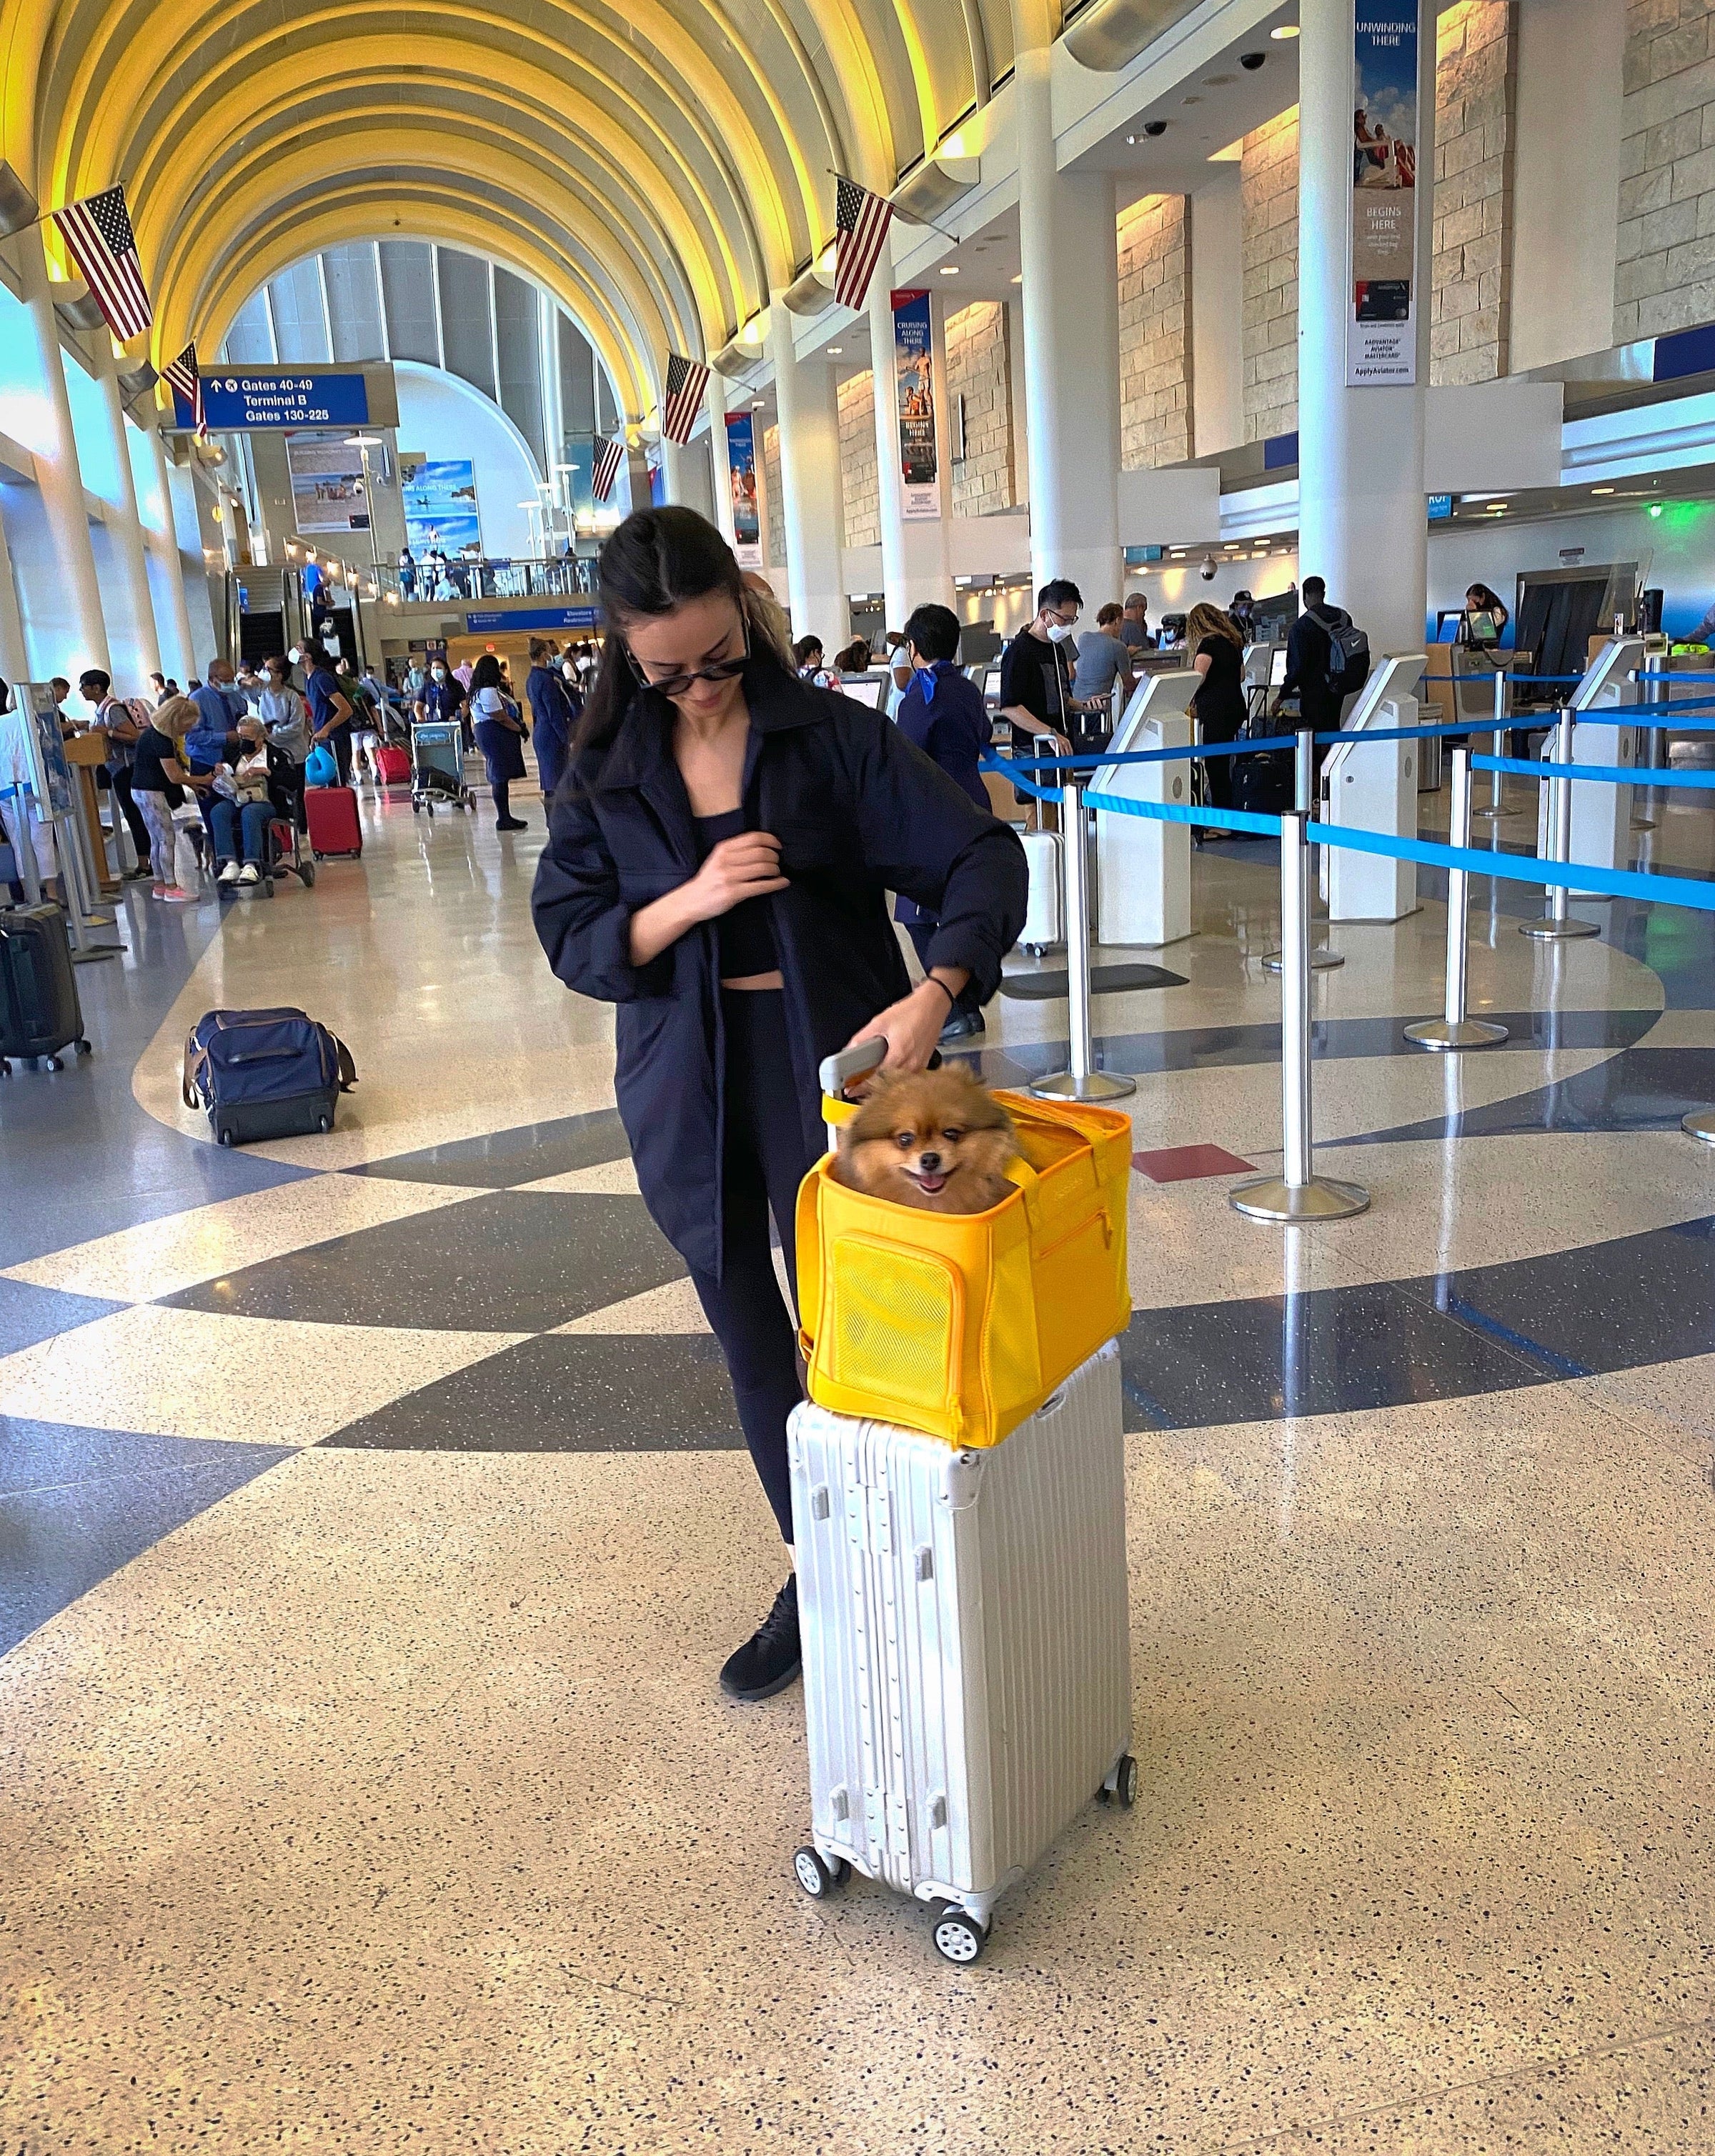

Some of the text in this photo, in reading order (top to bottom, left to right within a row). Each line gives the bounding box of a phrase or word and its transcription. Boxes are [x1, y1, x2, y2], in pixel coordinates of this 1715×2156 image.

[1356, 21, 1416, 34] UNWINDING
[1373, 34, 1401, 46] THERE
[1366, 206, 1401, 217] BEGINS
[1371, 219, 1396, 230] HERE
[242, 379, 313, 391] Gates 40-49
[244, 394, 307, 406] Terminal B
[245, 409, 329, 421] Gates 130-225
